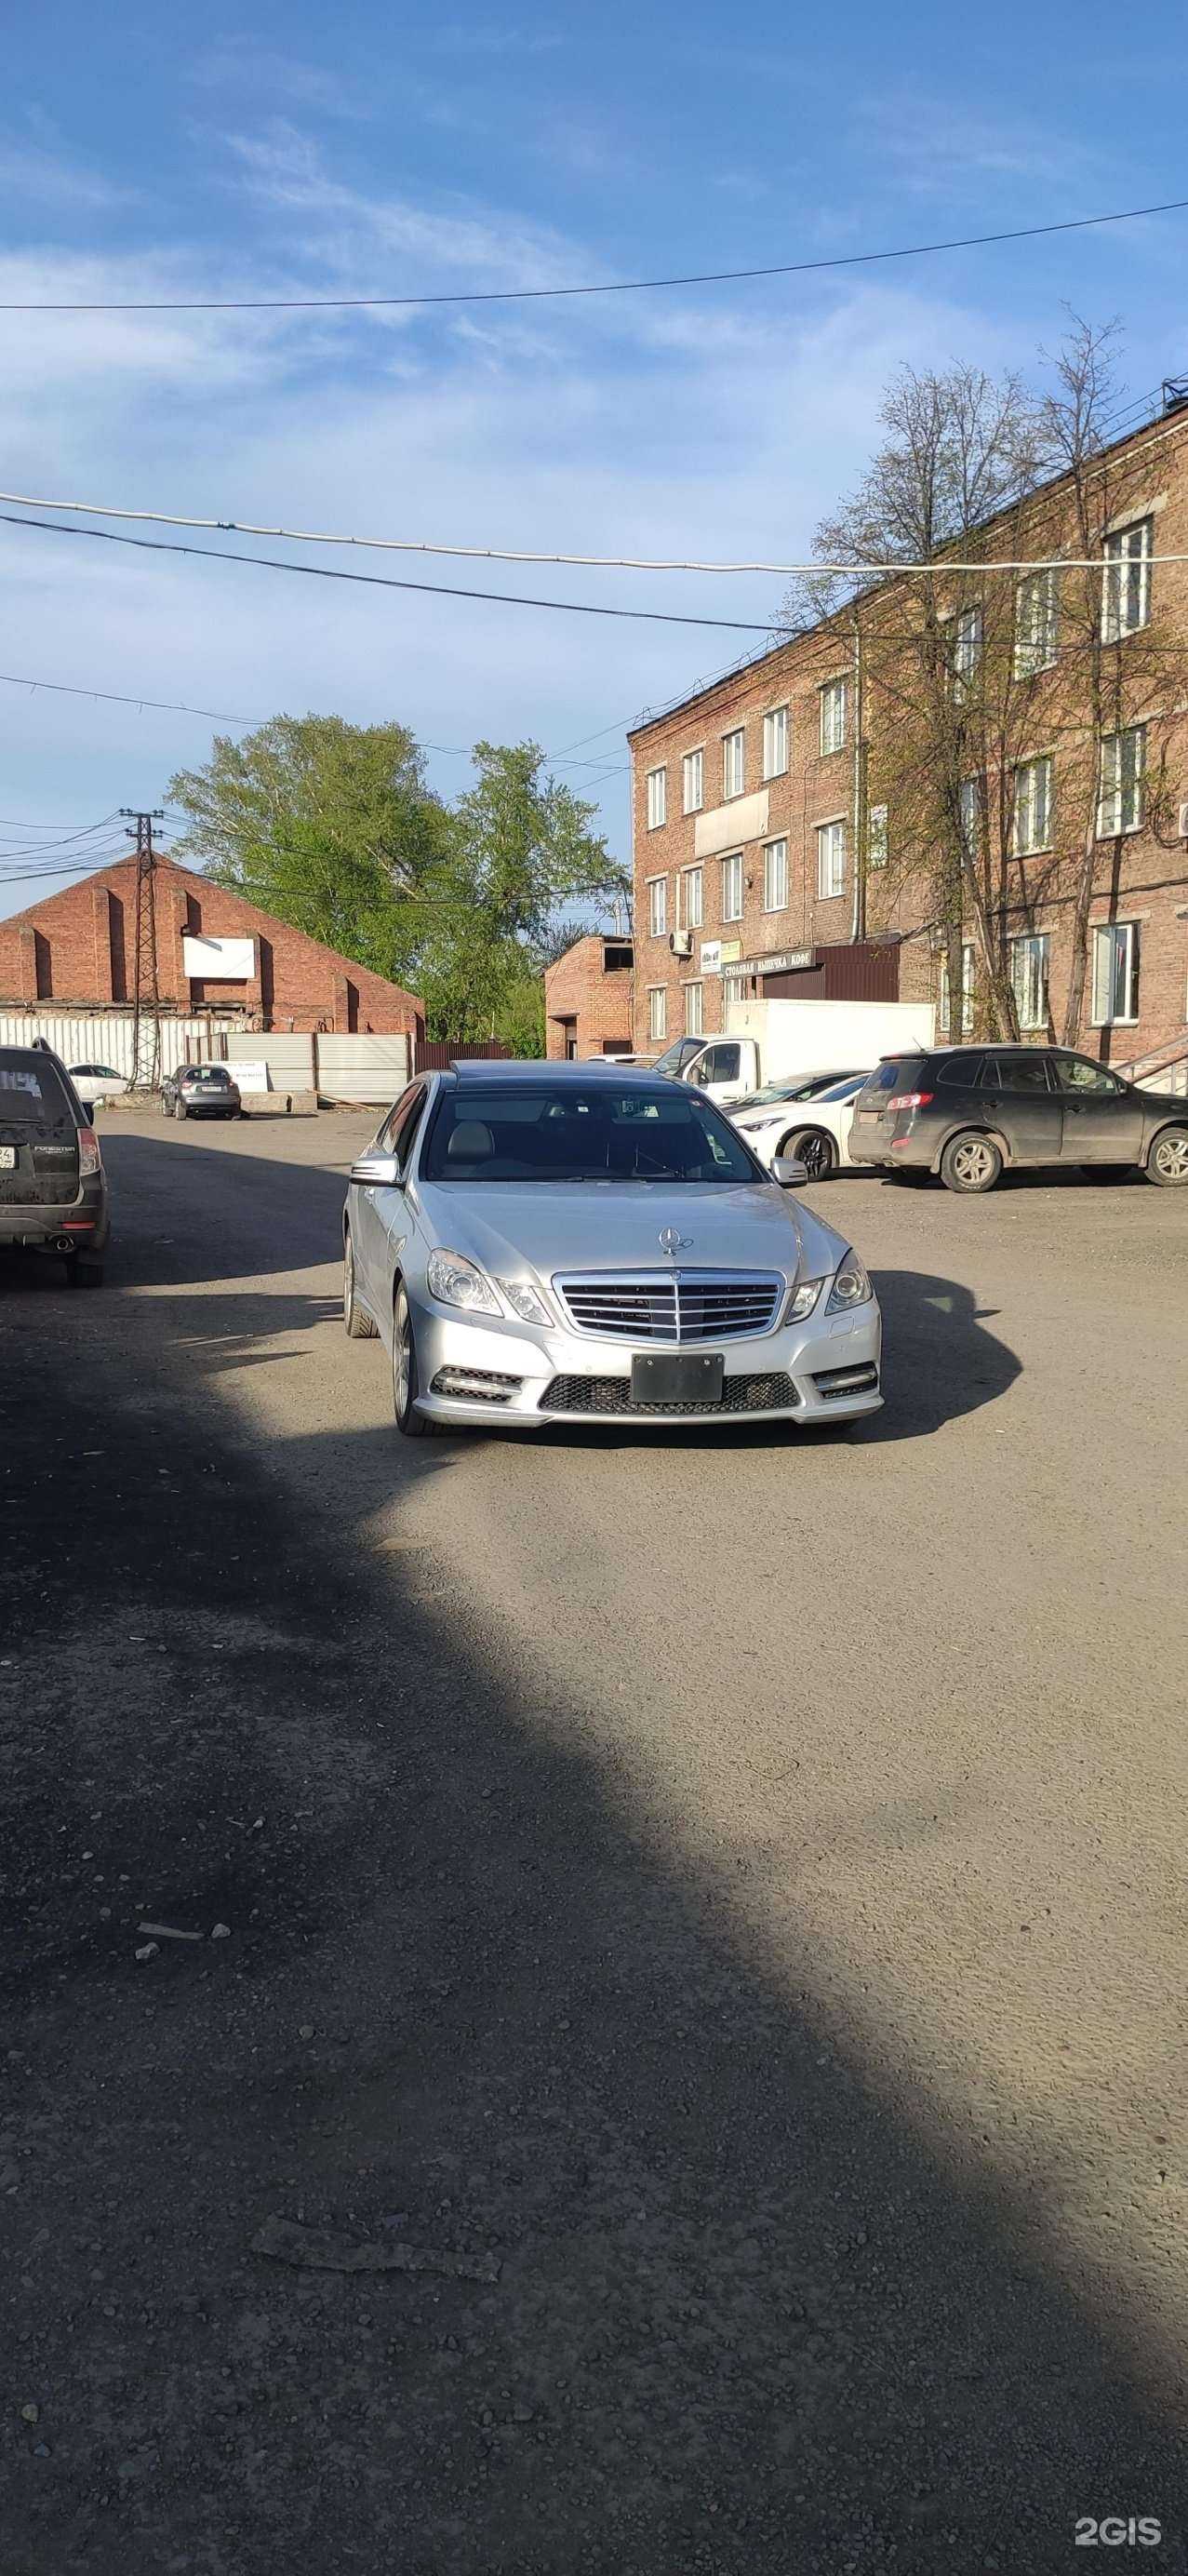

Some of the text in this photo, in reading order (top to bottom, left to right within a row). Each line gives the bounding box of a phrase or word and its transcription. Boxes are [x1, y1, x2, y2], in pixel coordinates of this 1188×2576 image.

[725, 962, 754, 977] СТОЛОВАЯ
[757, 956, 787, 972] ВЫПЕЧКА
[791, 952, 809, 966] КОФЕ
